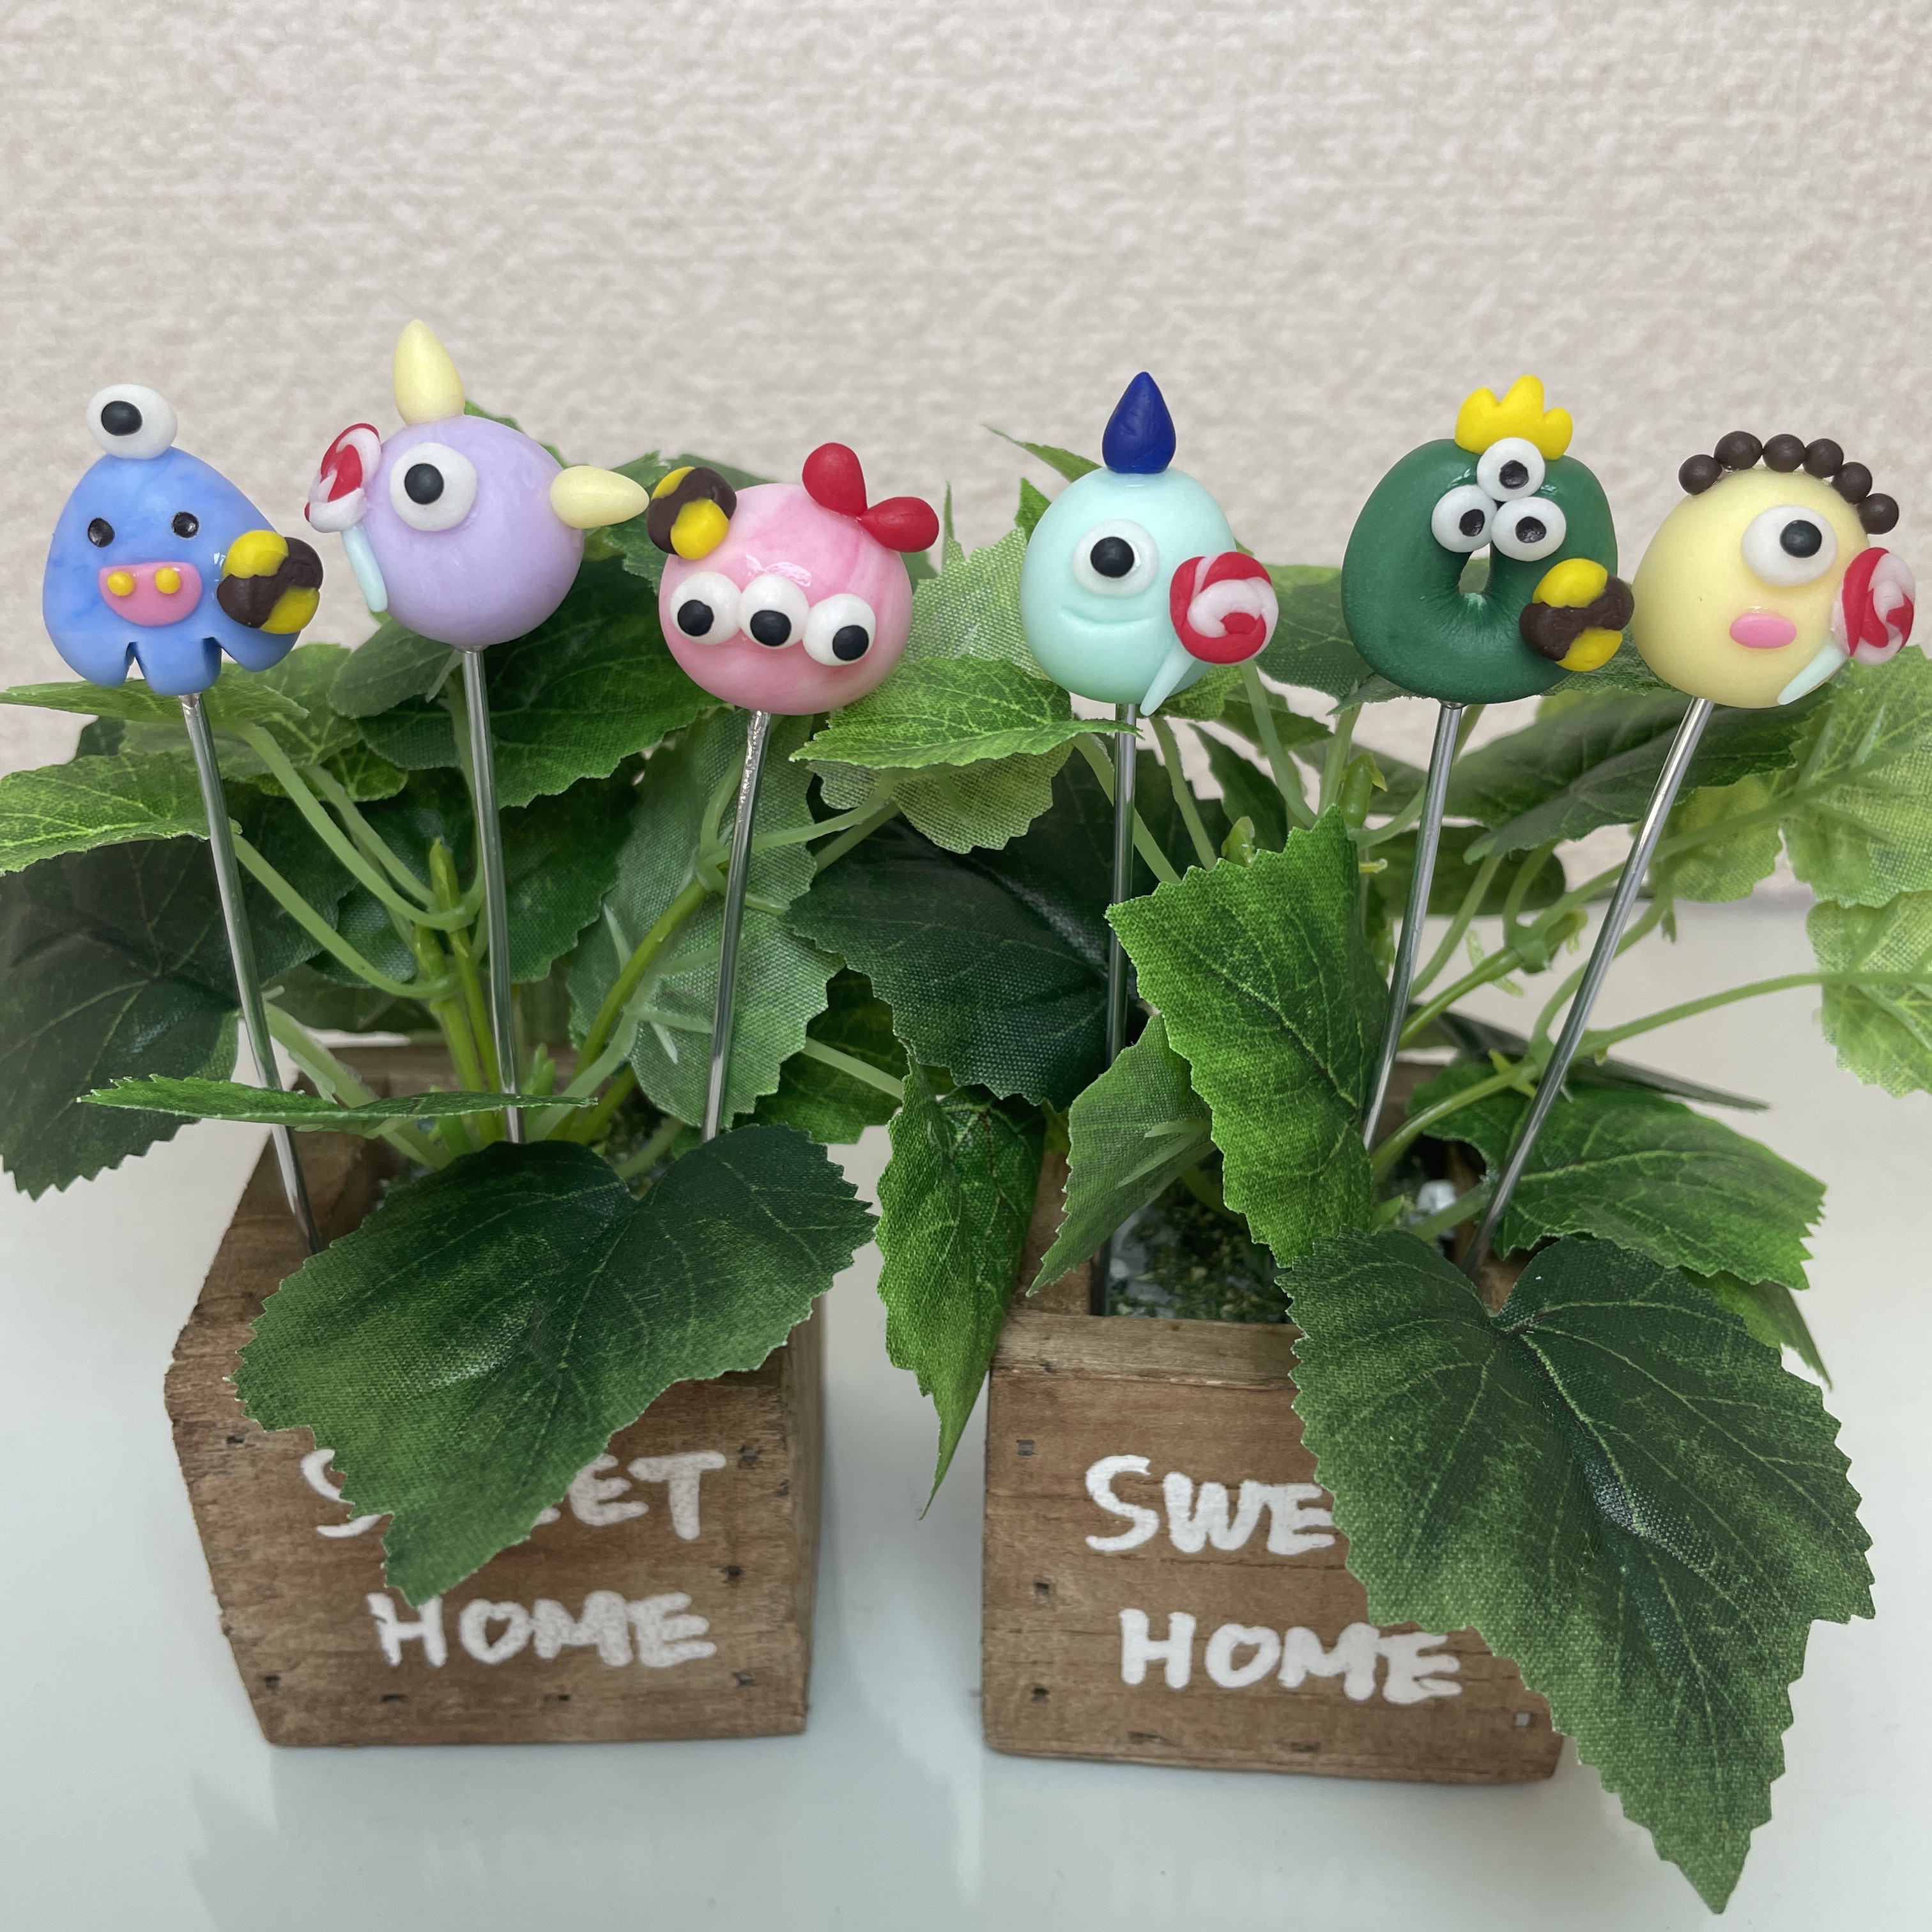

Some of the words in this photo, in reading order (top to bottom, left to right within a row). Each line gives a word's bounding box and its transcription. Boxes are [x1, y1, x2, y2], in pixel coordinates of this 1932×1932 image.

[299, 1448, 727, 1540] SET
[1085, 1453, 1336, 1556] SWE
[366, 1590, 717, 1669] HOME
[1118, 1607, 1463, 1705] HOME
